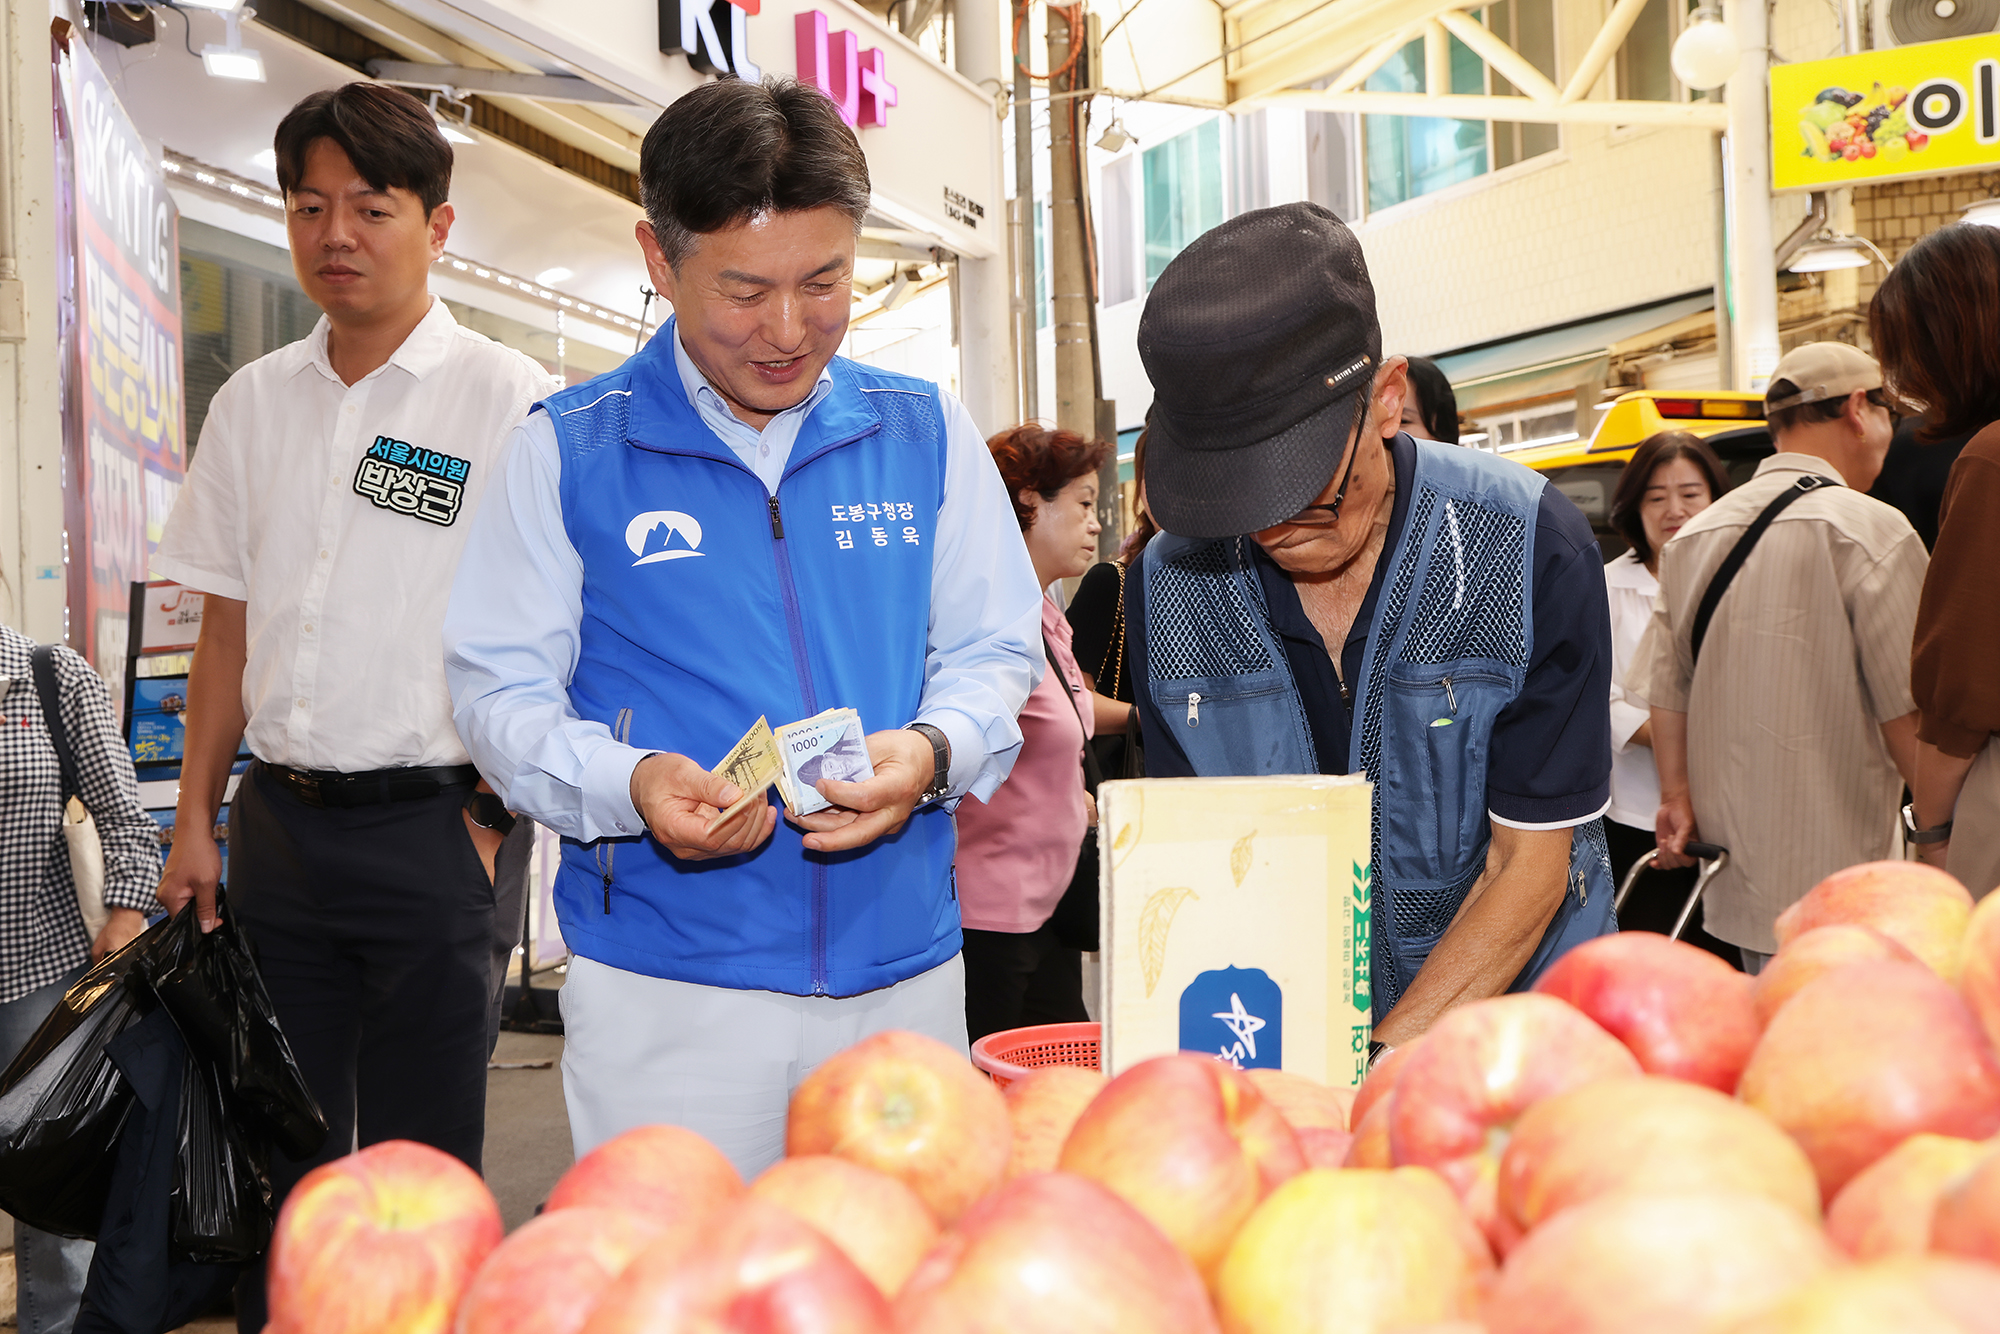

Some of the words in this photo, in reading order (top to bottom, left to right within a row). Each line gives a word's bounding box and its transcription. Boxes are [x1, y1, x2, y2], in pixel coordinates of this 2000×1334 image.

[797, 10, 897, 127] U+
[82, 80, 113, 221] SK
[118, 136, 145, 256] KT
[147, 184, 169, 293] LG
[369, 437, 469, 482] 서울시의원
[360, 462, 457, 520] 박상근
[831, 501, 914, 522] 도봉구청장
[740, 723, 763, 751] 50000
[791, 736, 818, 754] 1000
[1355, 920, 1370, 996] 身土不二
